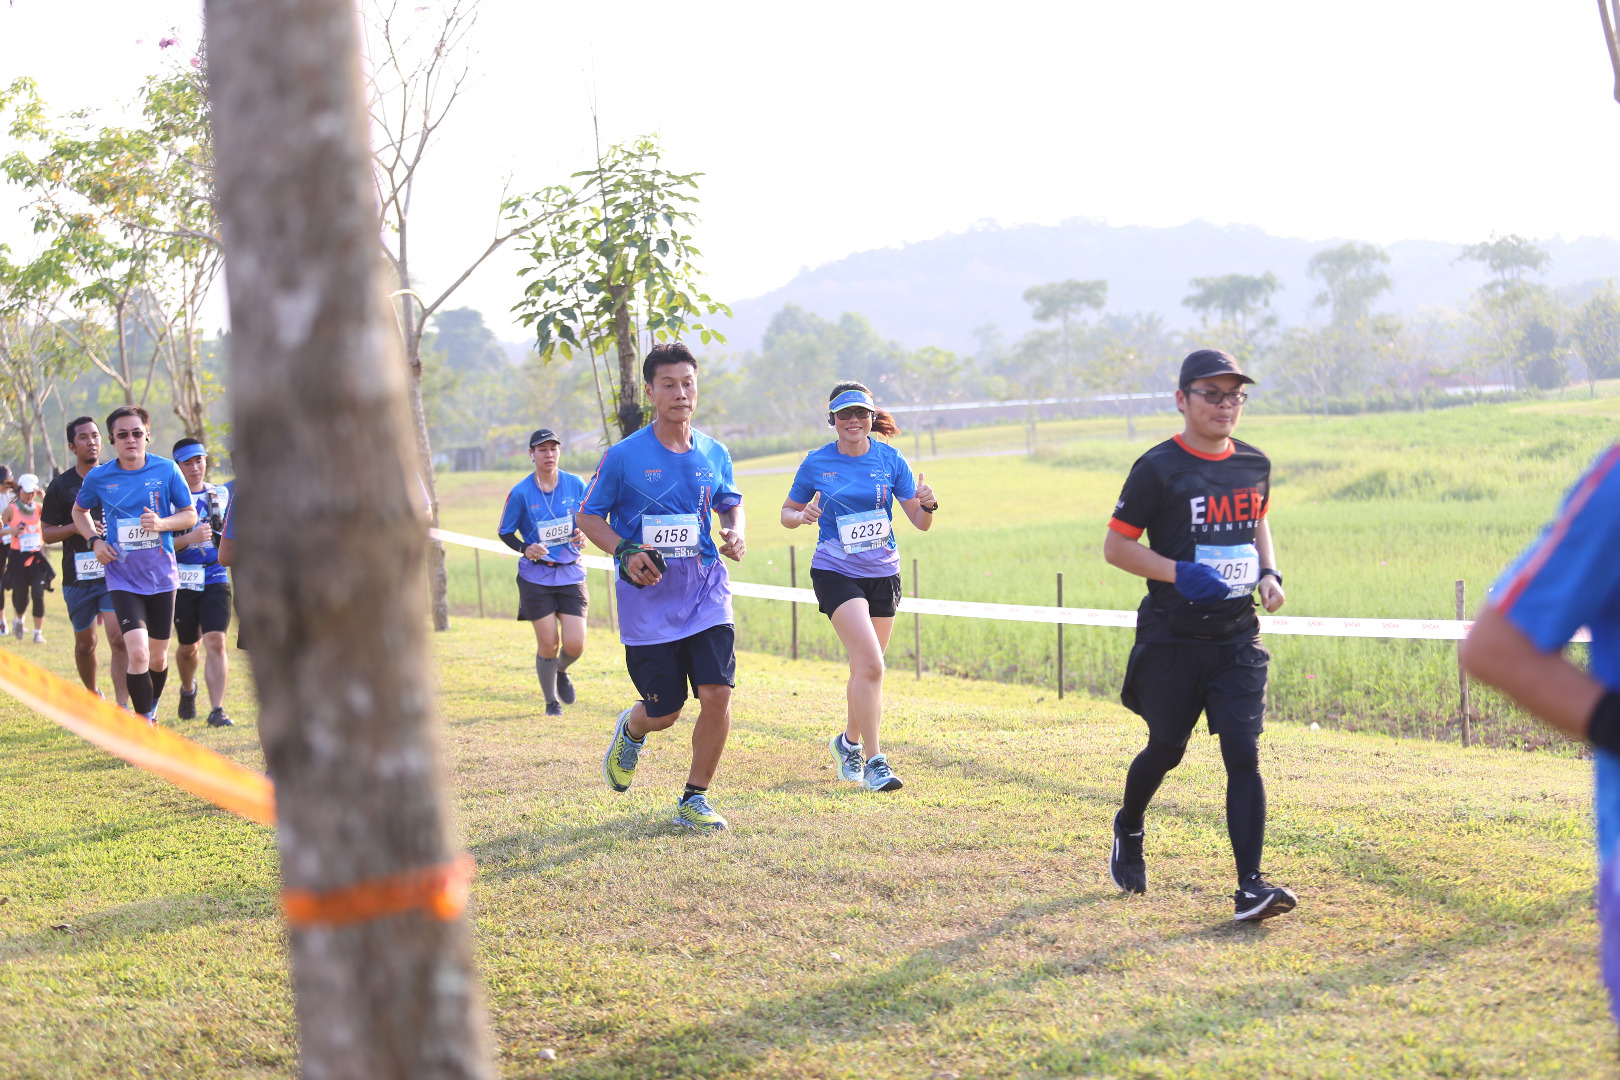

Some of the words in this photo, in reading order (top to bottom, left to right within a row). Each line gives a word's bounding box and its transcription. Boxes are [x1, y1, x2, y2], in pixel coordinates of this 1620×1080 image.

[545, 525, 569, 538] 6058
[654, 528, 688, 543] 6158
[851, 522, 882, 540] 6232
